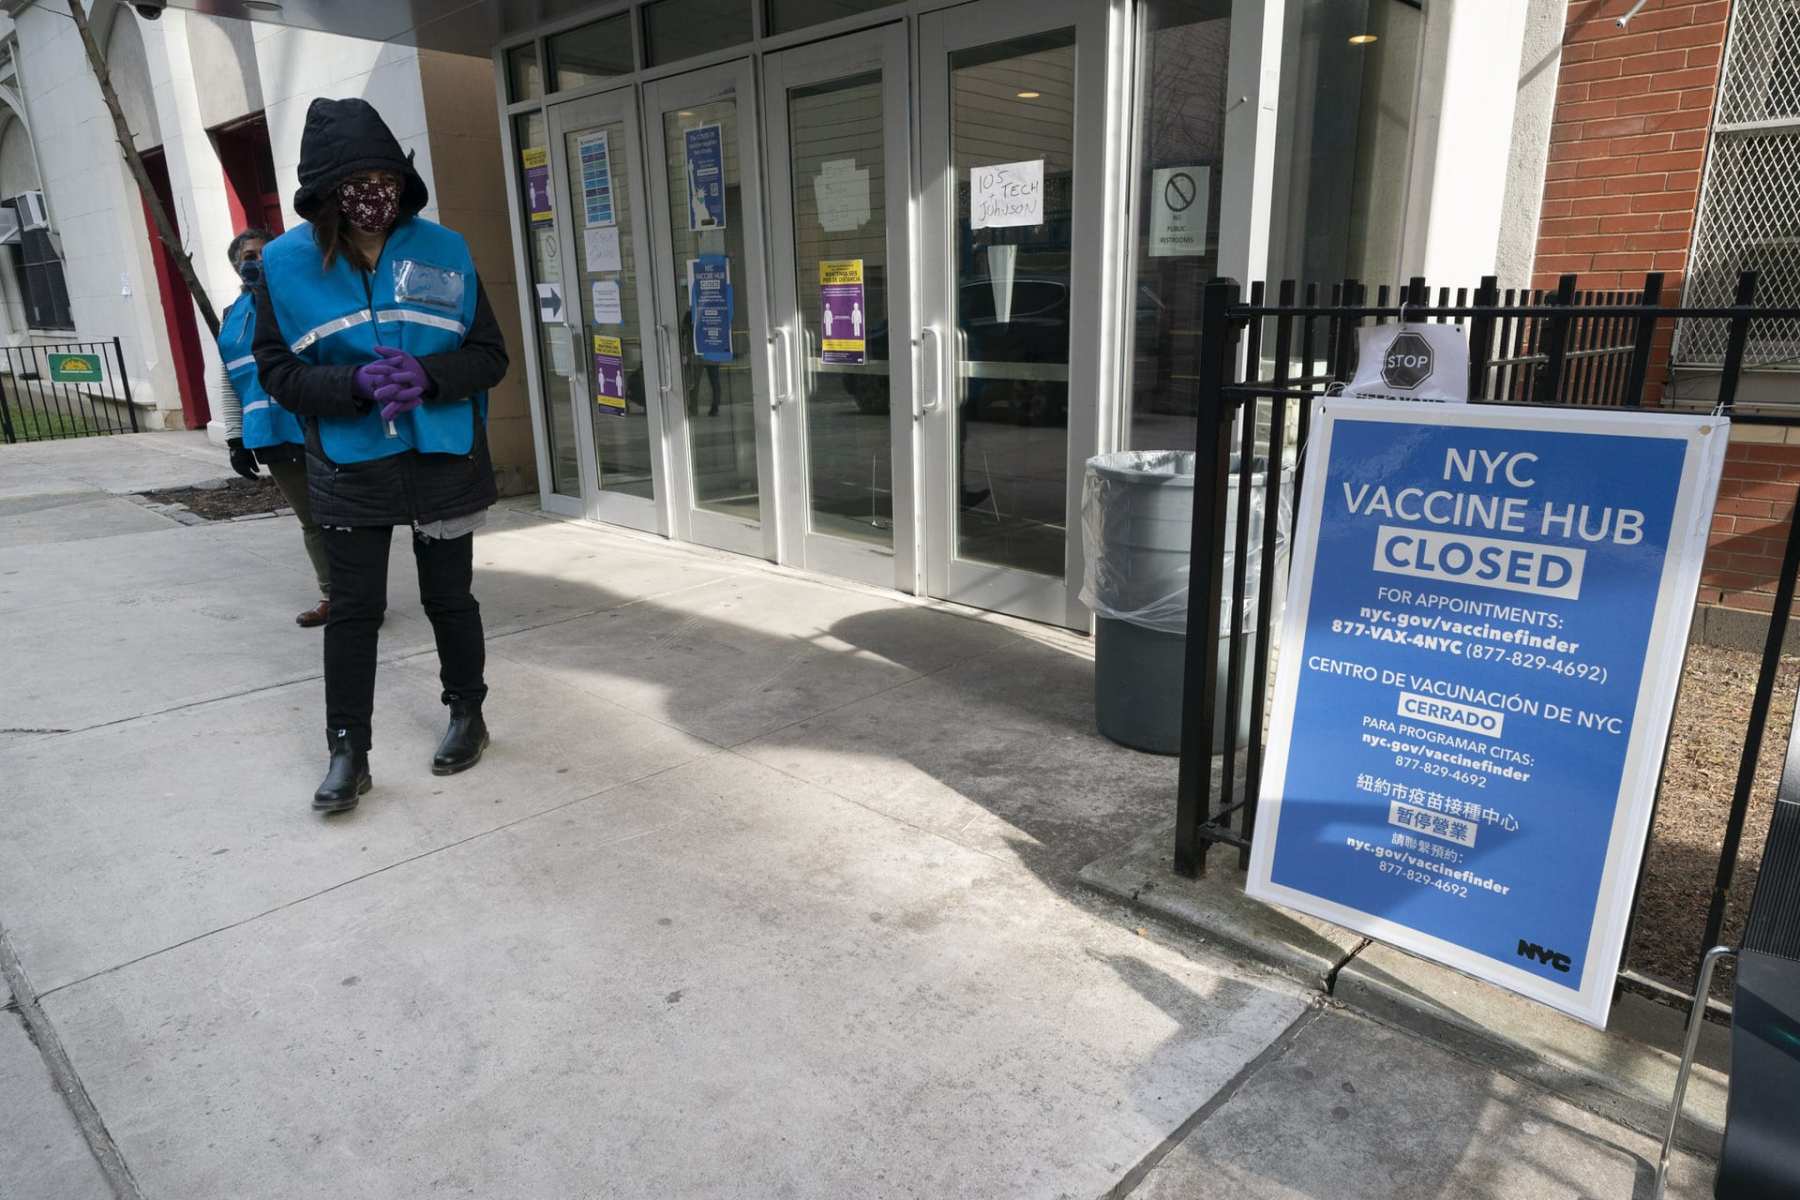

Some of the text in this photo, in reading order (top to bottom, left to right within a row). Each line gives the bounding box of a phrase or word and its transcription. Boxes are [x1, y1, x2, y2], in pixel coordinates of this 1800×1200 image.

[1001, 181, 1039, 200] TECH
[1388, 354, 1428, 369] STOP
[1443, 447, 1539, 488] NYC
[1343, 482, 1645, 545] VACCINE HUB
[1384, 535, 1573, 589] CLOSED
[1360, 605, 1579, 655] nyc.gov/vaccinefinder
[1378, 587, 1564, 630] FOR APPOINTMENTS:
[1331, 621, 1608, 685] 877-VAX-4NYC (877-829-4692)
[1309, 656, 1623, 735] CENTRO DE VACUNACIÓN DE NYC
[1404, 698, 1497, 732] CERRADO
[1362, 731, 1530, 783] nyc.gov/vaccinefinder
[1363, 716, 1535, 767] PARA PROGRAMAR CITAS:
[1396, 756, 1487, 788] 877-829-4692
[1356, 773, 1519, 833] 紐約市疫苗接種中心
[1396, 807, 1468, 841] 暫停營業
[1346, 836, 1510, 896] nyc.gov/vaccinefinder
[1379, 861, 1468, 898] 877-829-4692
[1517, 940, 1572, 973] NYC
